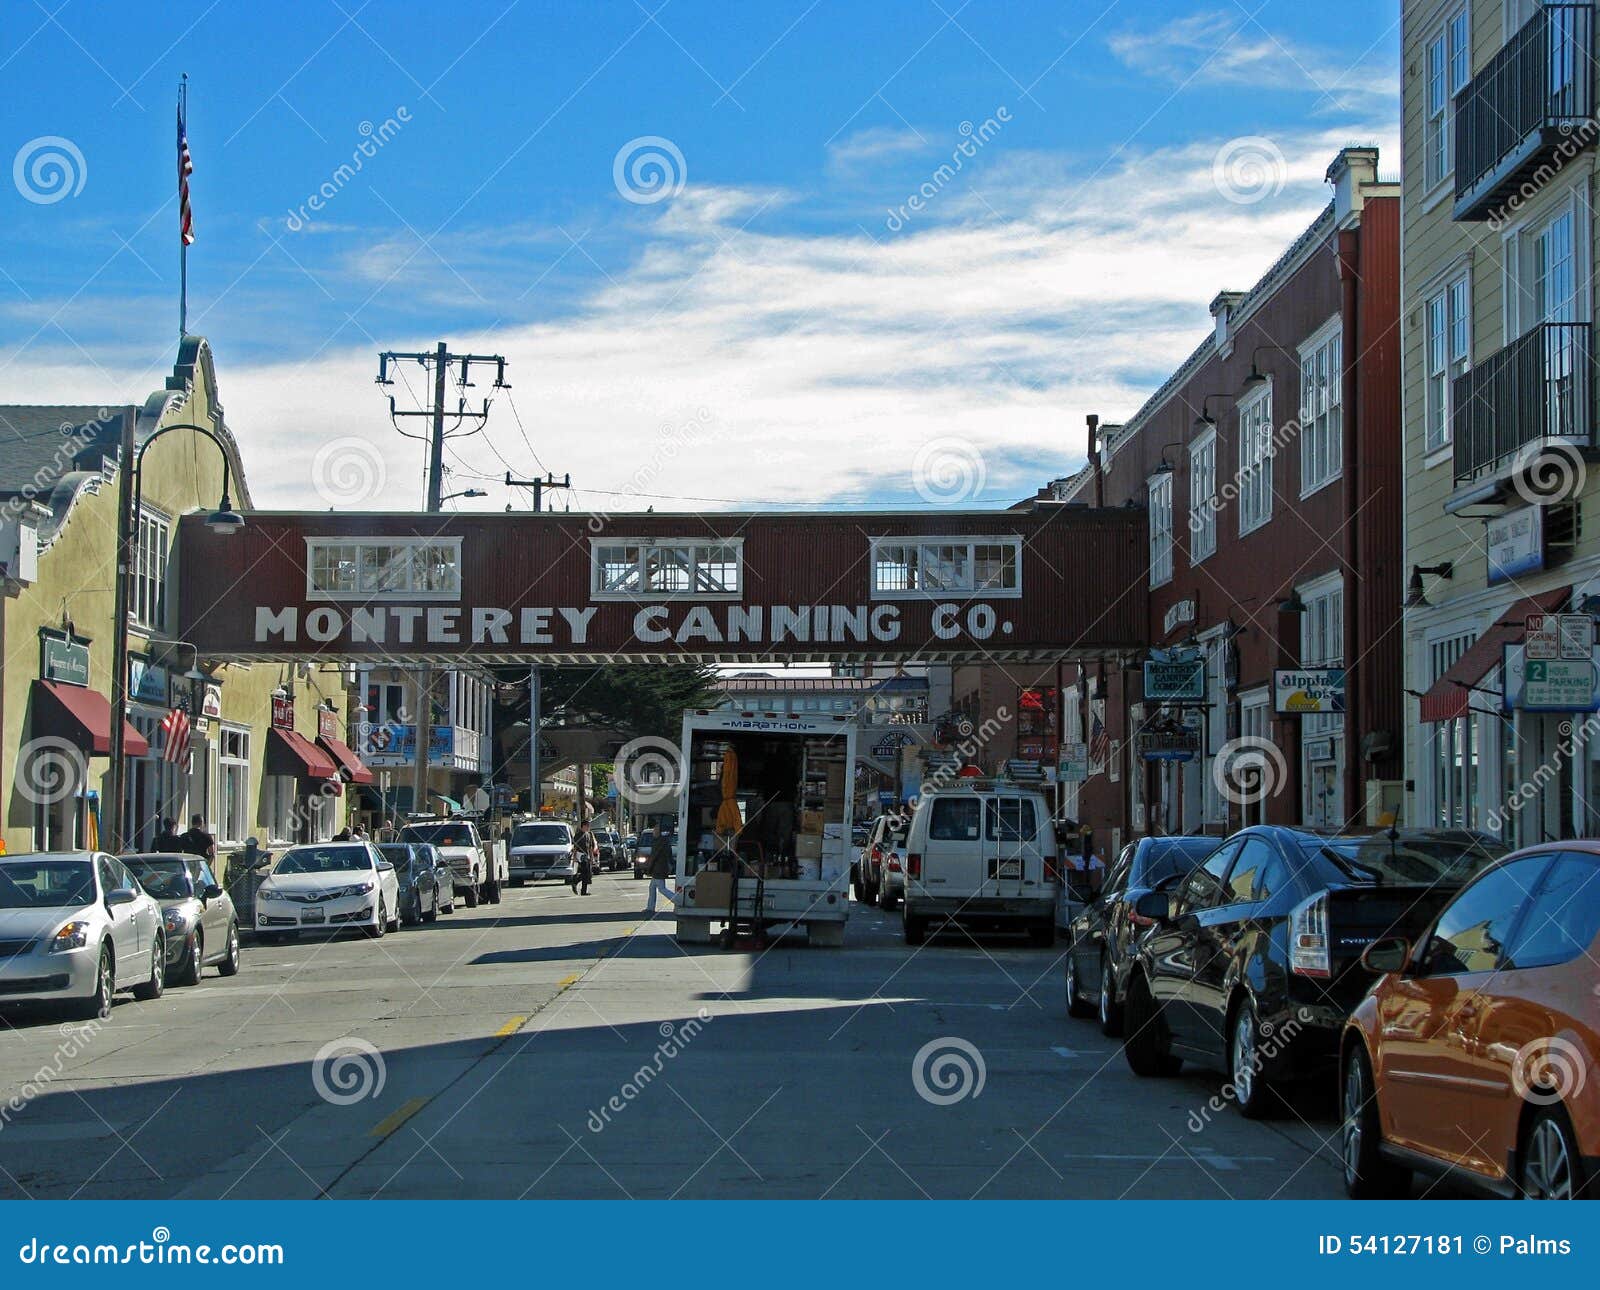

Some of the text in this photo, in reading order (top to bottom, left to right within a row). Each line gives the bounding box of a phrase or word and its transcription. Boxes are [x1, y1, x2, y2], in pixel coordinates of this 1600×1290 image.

[254, 604, 1014, 644] MONTEREY CANNING CO.
[1528, 617, 1541, 630] NO
[1149, 663, 1198, 674] MONTEREY
[1532, 663, 1542, 680] 2
[1549, 677, 1590, 688] PARKING
